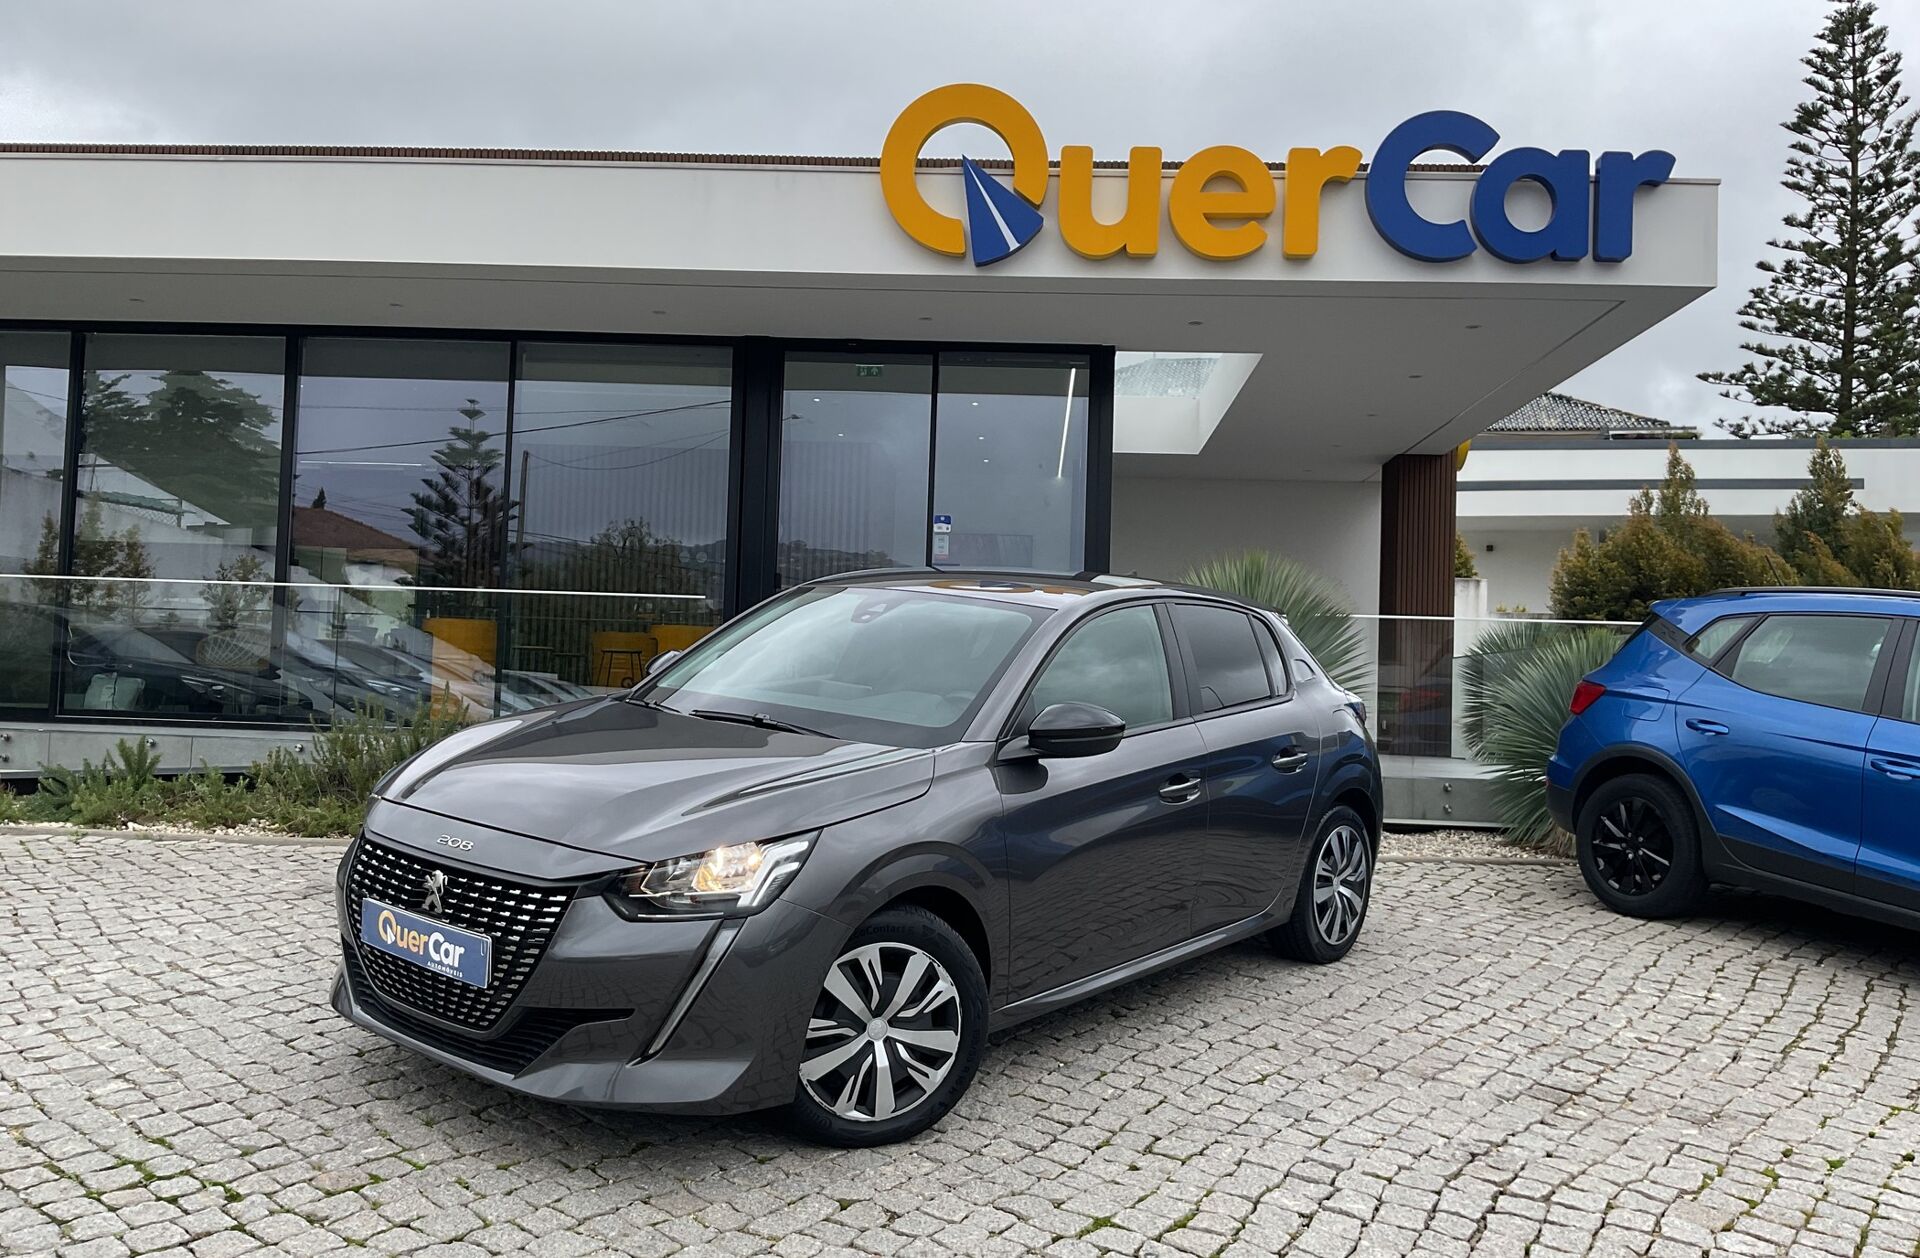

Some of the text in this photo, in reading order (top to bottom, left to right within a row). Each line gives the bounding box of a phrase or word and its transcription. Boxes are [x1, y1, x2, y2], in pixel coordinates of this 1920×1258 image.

[880, 83, 1677, 267] QuerCar
[436, 834, 474, 850] 208
[378, 910, 465, 968] QuerCar
